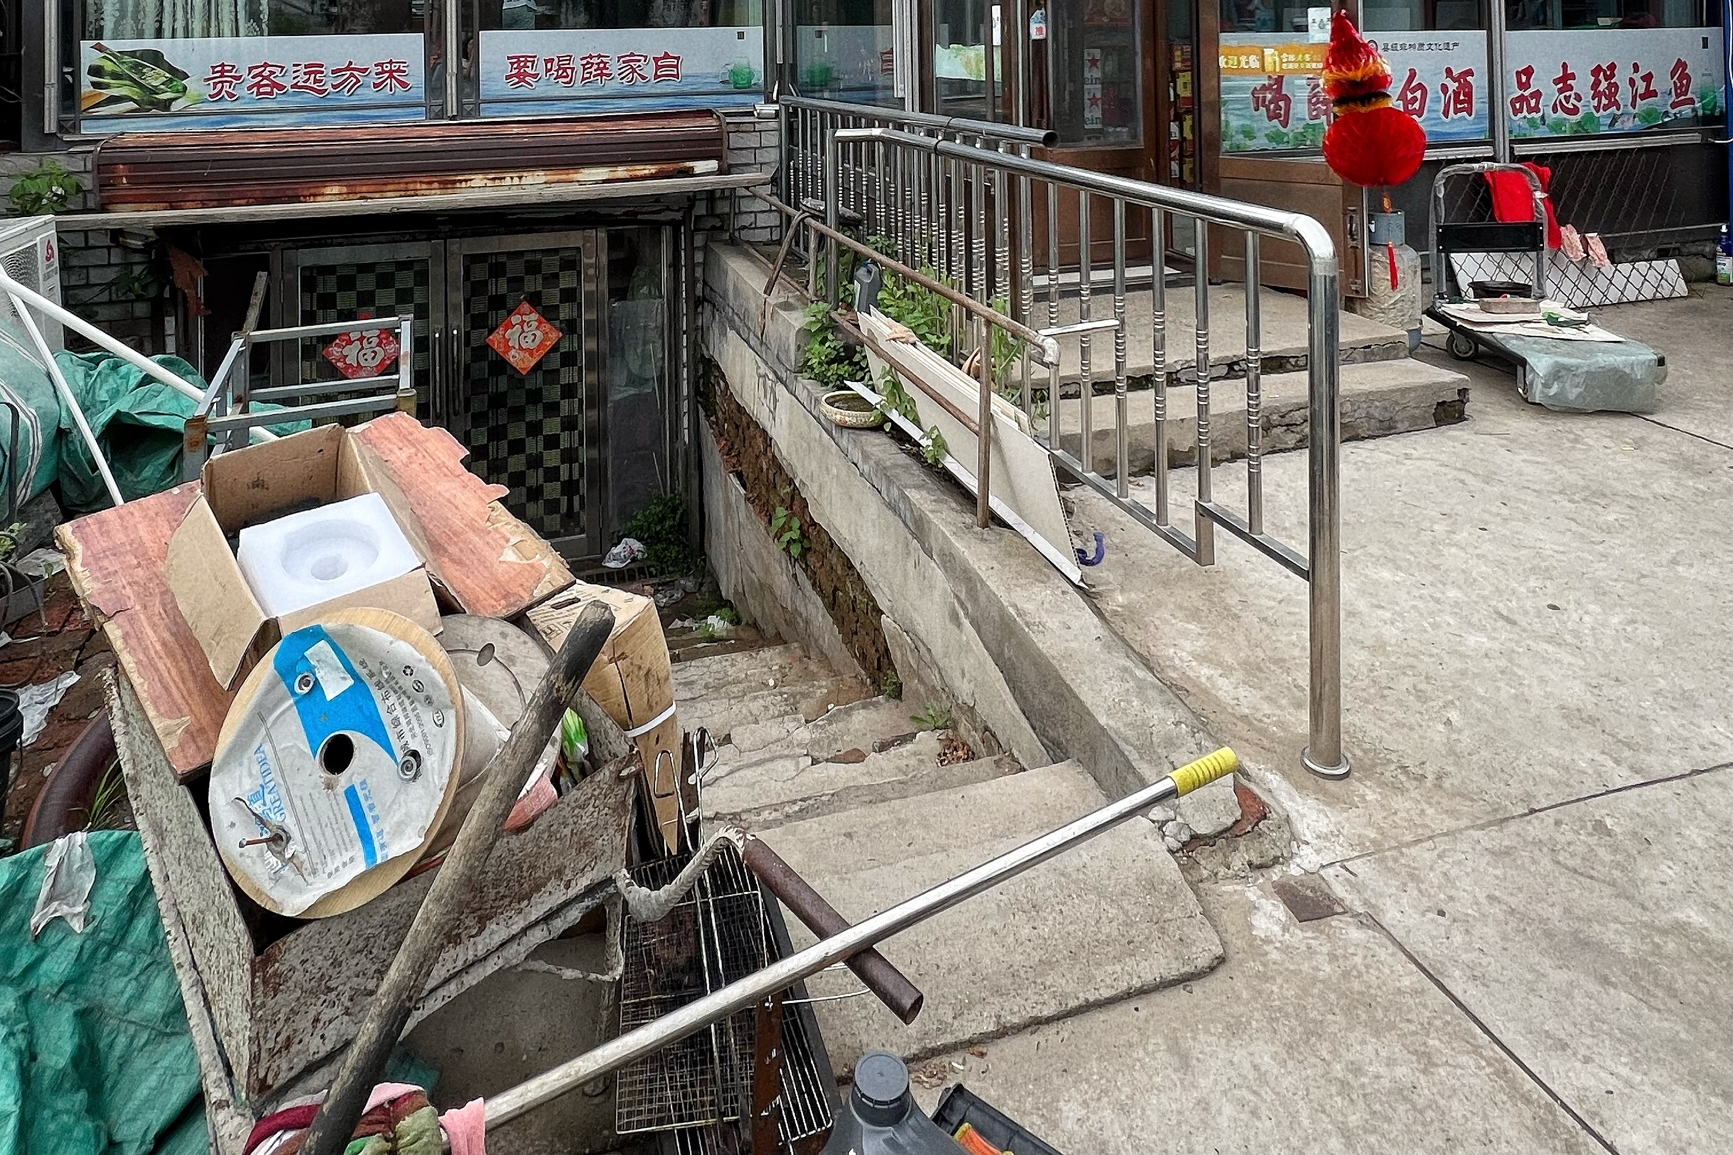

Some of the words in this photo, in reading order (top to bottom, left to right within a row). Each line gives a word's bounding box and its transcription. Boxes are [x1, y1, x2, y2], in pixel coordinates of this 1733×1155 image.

[202, 59, 412, 101] 贵客远方来
[504, 50, 682, 88] 要喝薛家白
[1509, 57, 1697, 117] 品志强江鱼
[505, 313, 543, 349] 福
